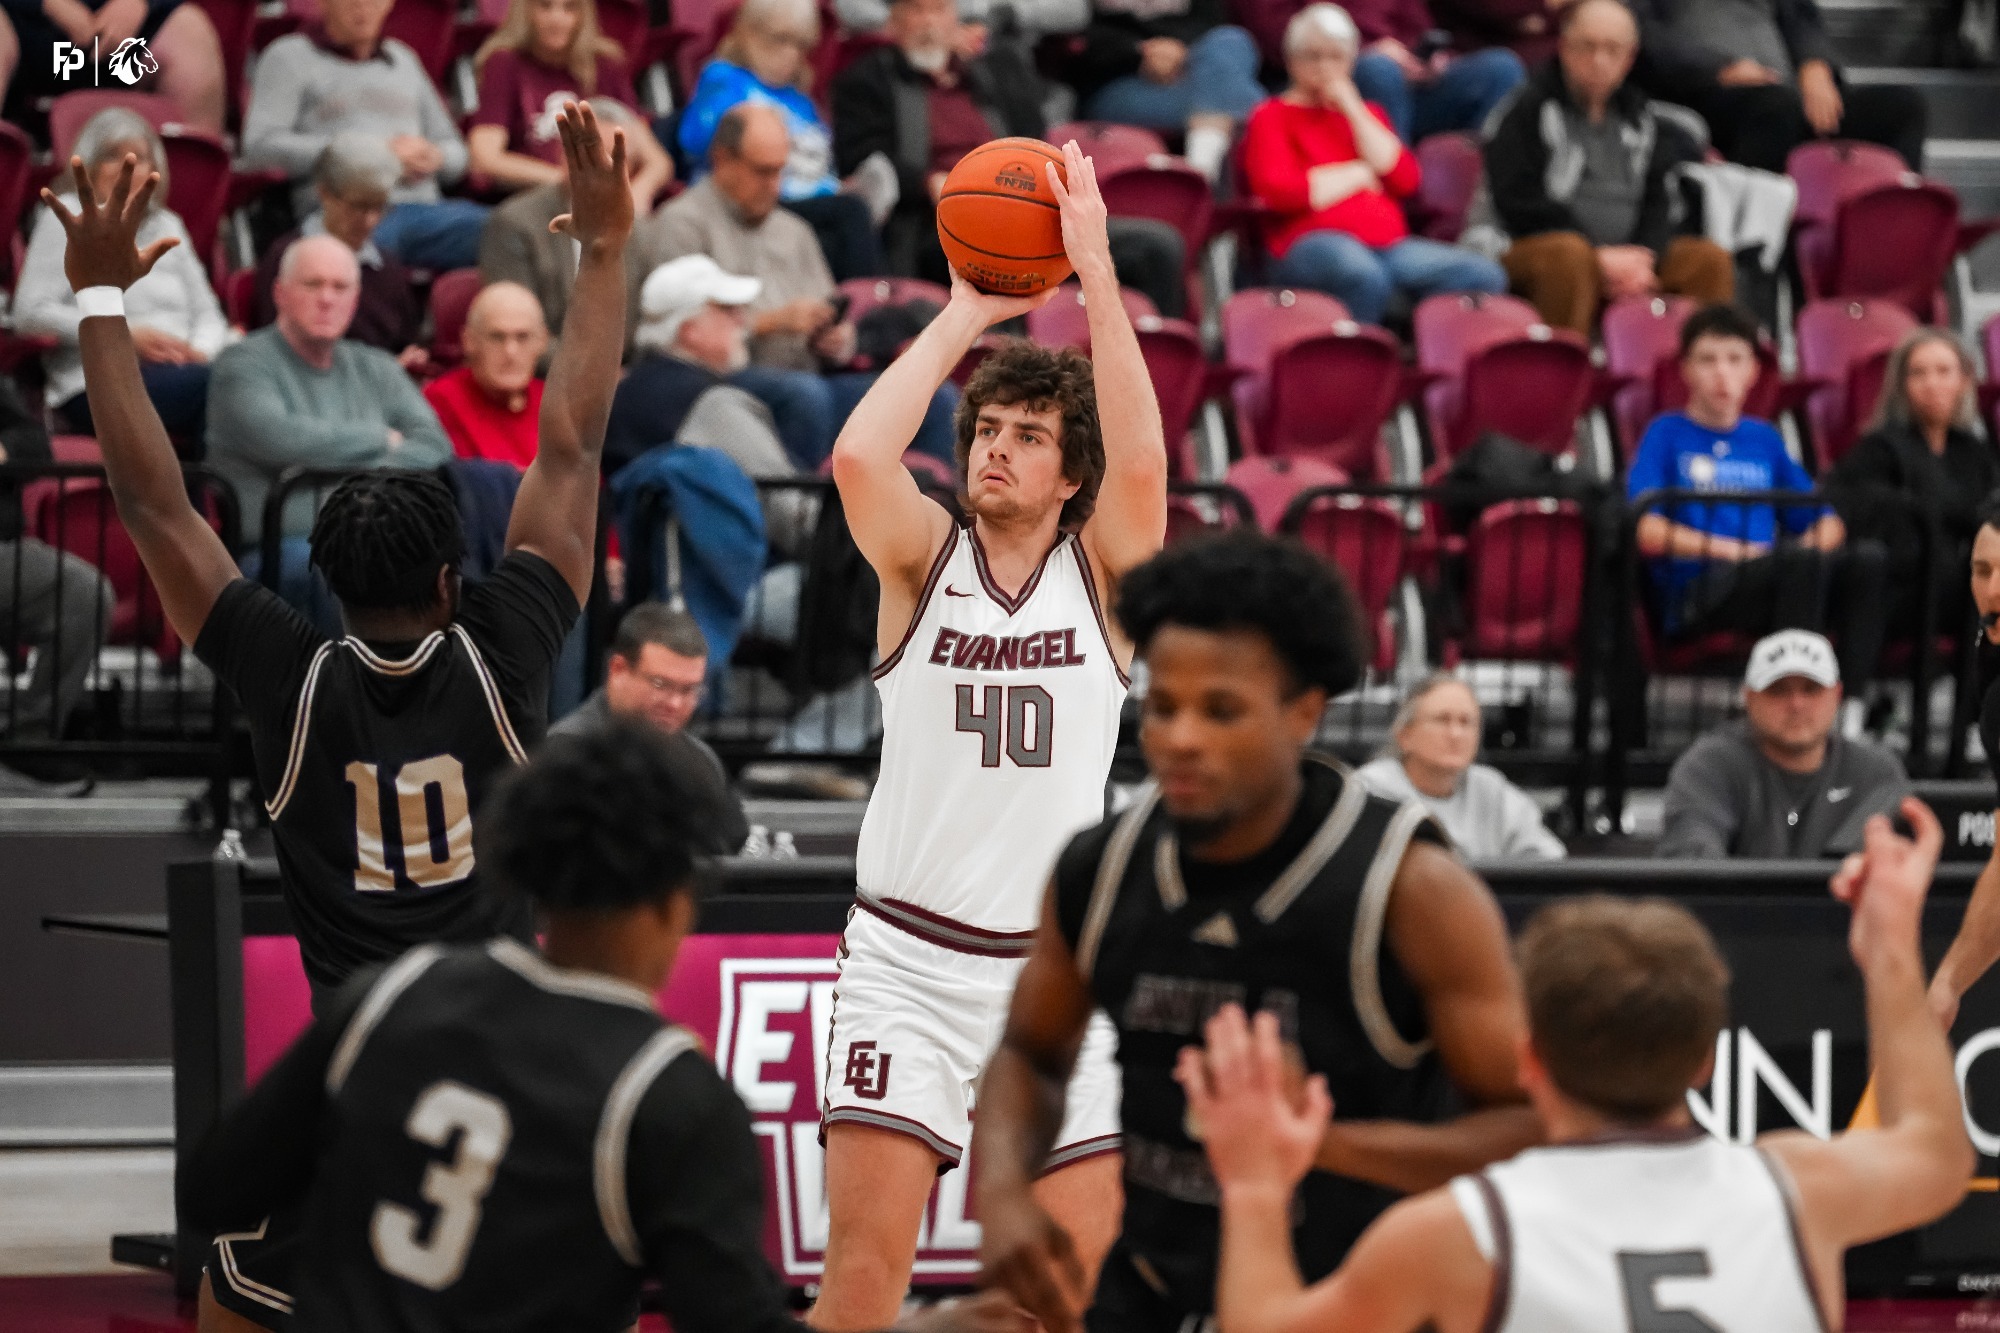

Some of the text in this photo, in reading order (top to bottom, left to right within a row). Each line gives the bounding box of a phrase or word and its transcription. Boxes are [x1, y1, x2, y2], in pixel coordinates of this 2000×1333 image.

[928, 626, 1086, 671] EVANGEL
[955, 684, 1053, 767] 40
[345, 753, 476, 891] 10
[844, 1040, 892, 1101] EU
[369, 1078, 513, 1292] 3
